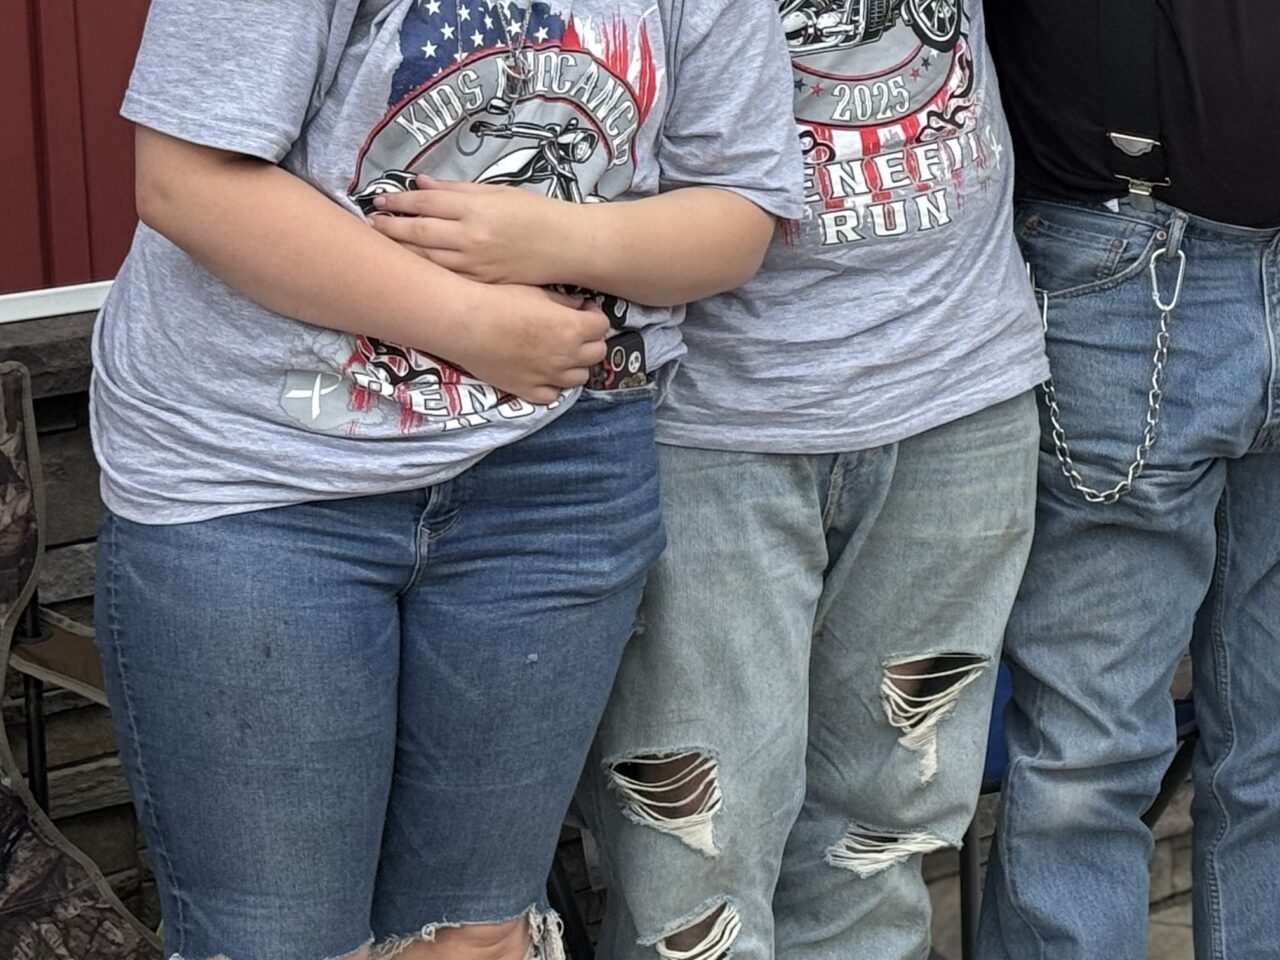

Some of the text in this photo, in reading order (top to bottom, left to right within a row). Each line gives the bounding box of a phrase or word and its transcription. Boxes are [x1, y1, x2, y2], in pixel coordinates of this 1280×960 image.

[396, 69, 484, 147] KIDS
[831, 78, 911, 123] 2025
[818, 187, 952, 246] RUN
